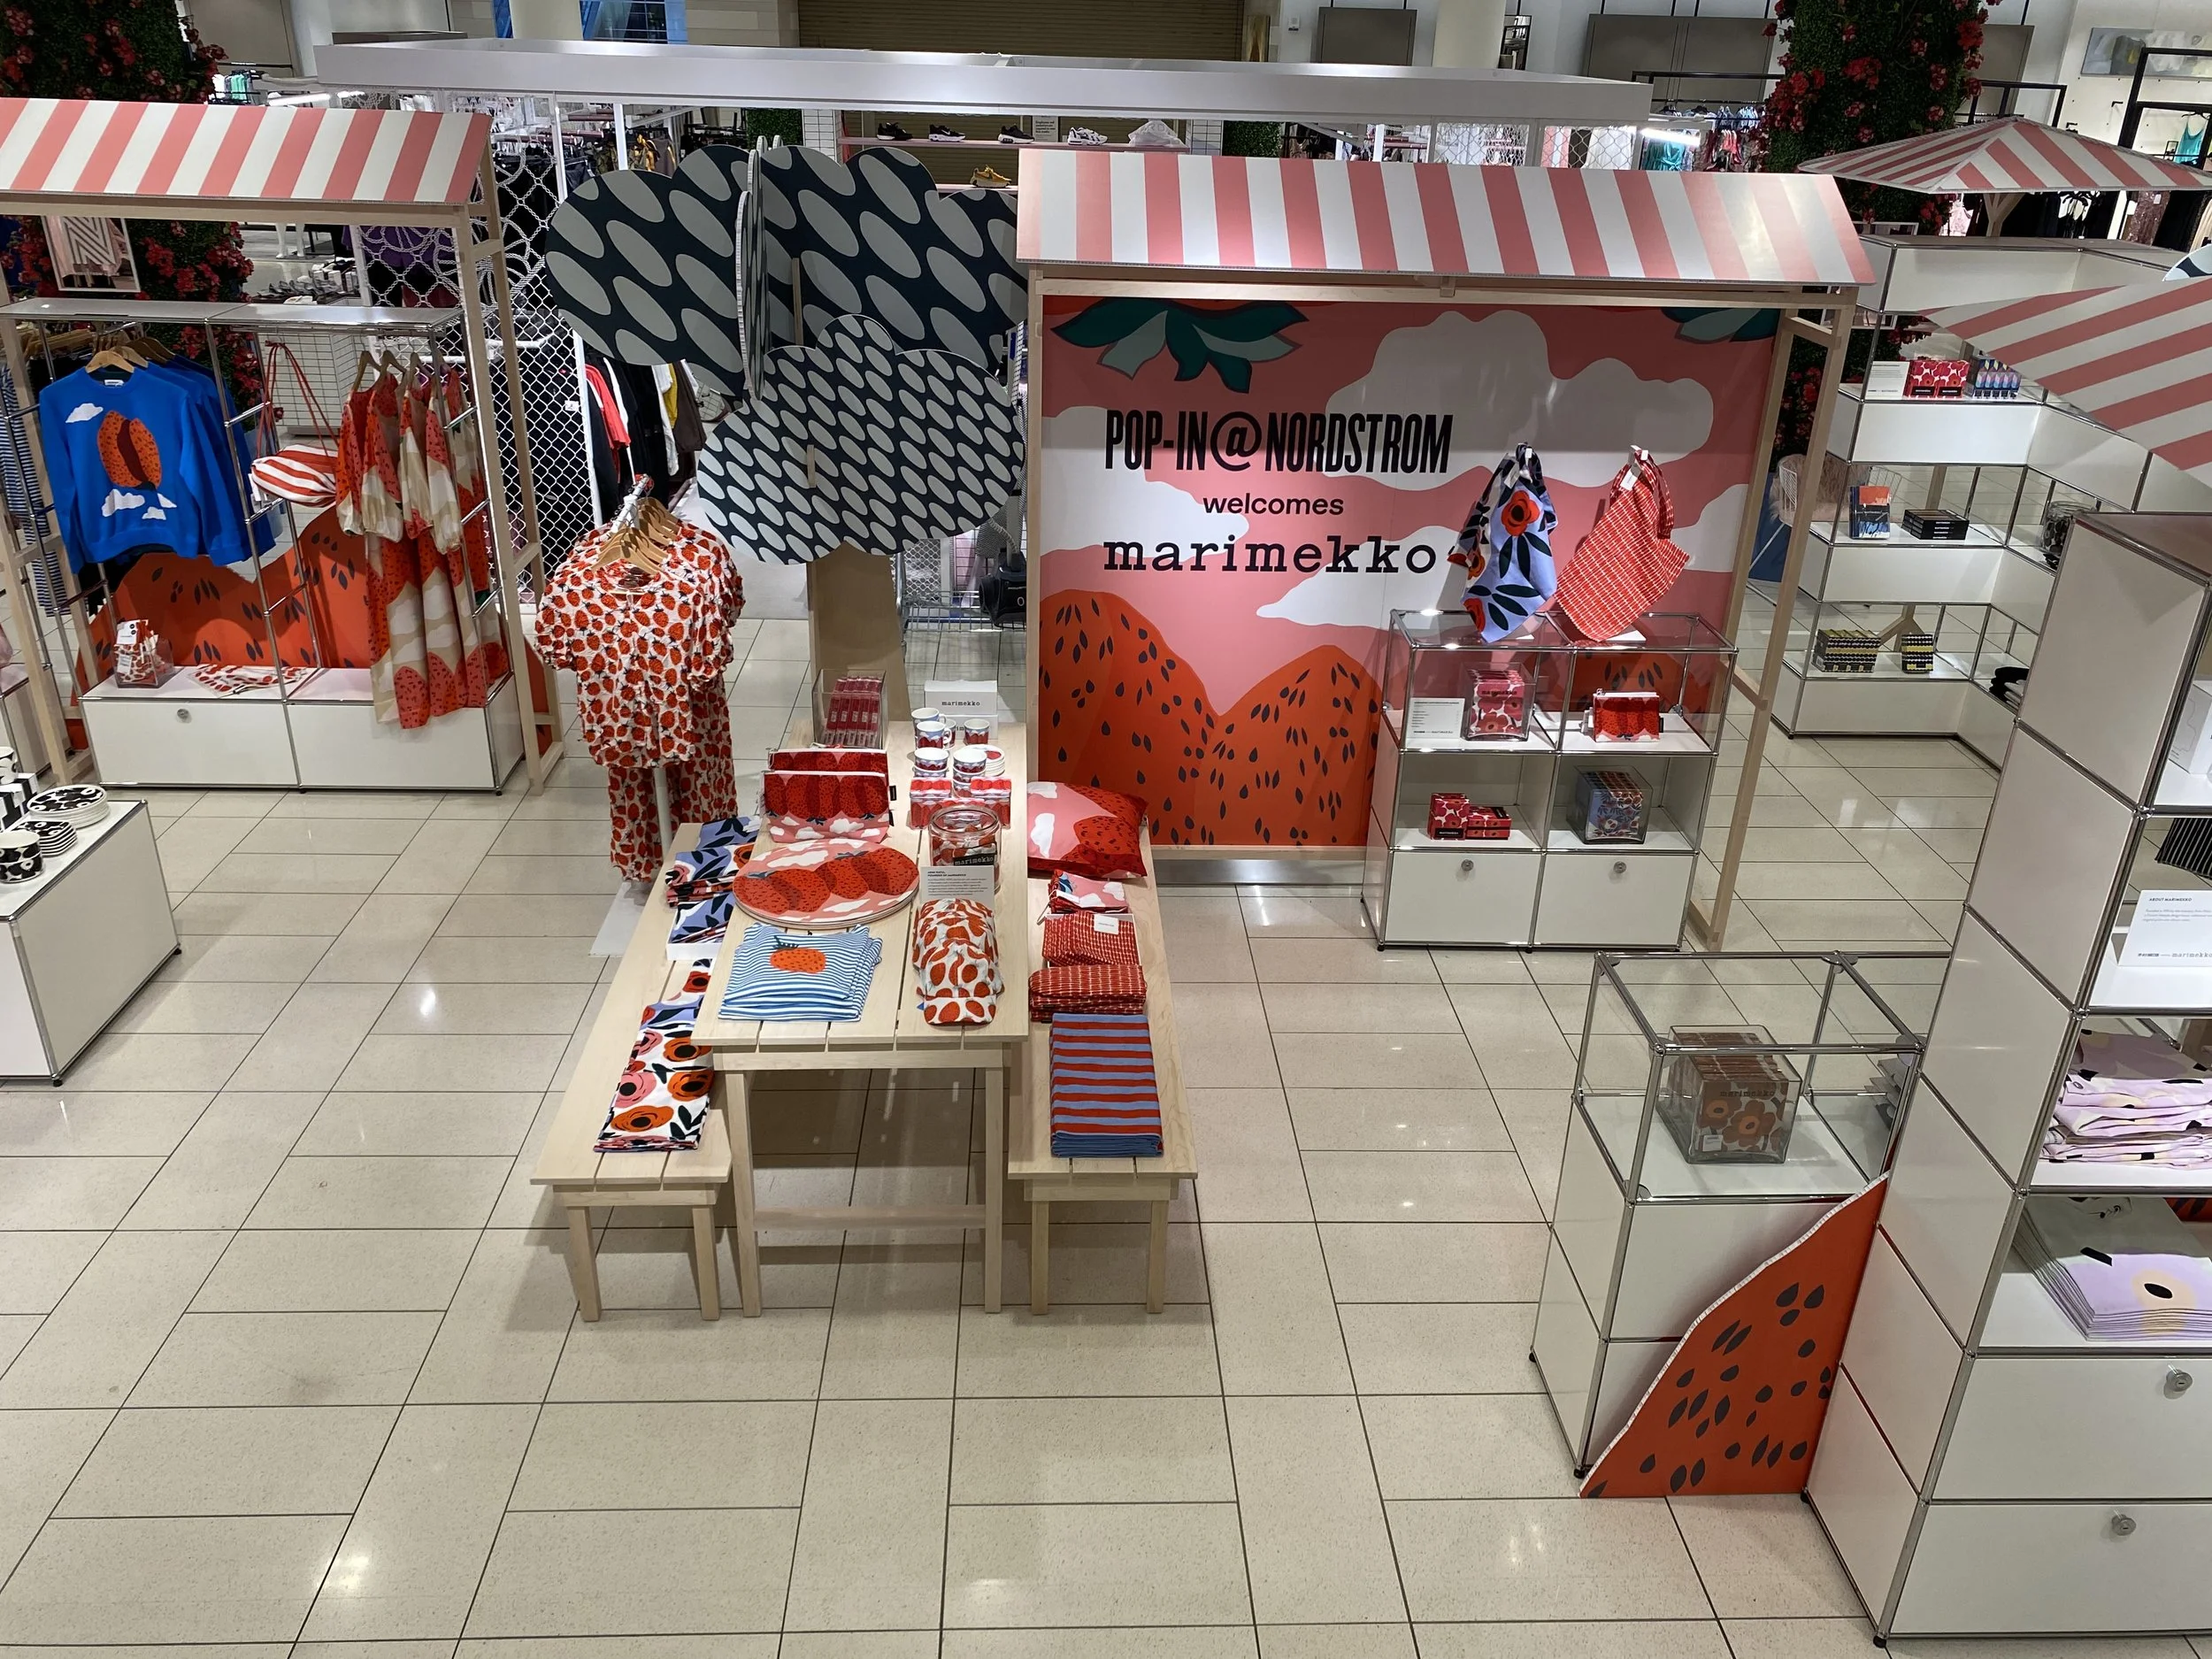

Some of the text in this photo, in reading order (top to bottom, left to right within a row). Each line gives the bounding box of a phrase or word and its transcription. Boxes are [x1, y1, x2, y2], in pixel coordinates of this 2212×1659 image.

[1105, 409, 1453, 473] POP-IN@NORDSTROM
[1202, 492, 1344, 516] welcomes
[1103, 534, 1437, 573] marimekko
[955, 856, 994, 865] marimekko
